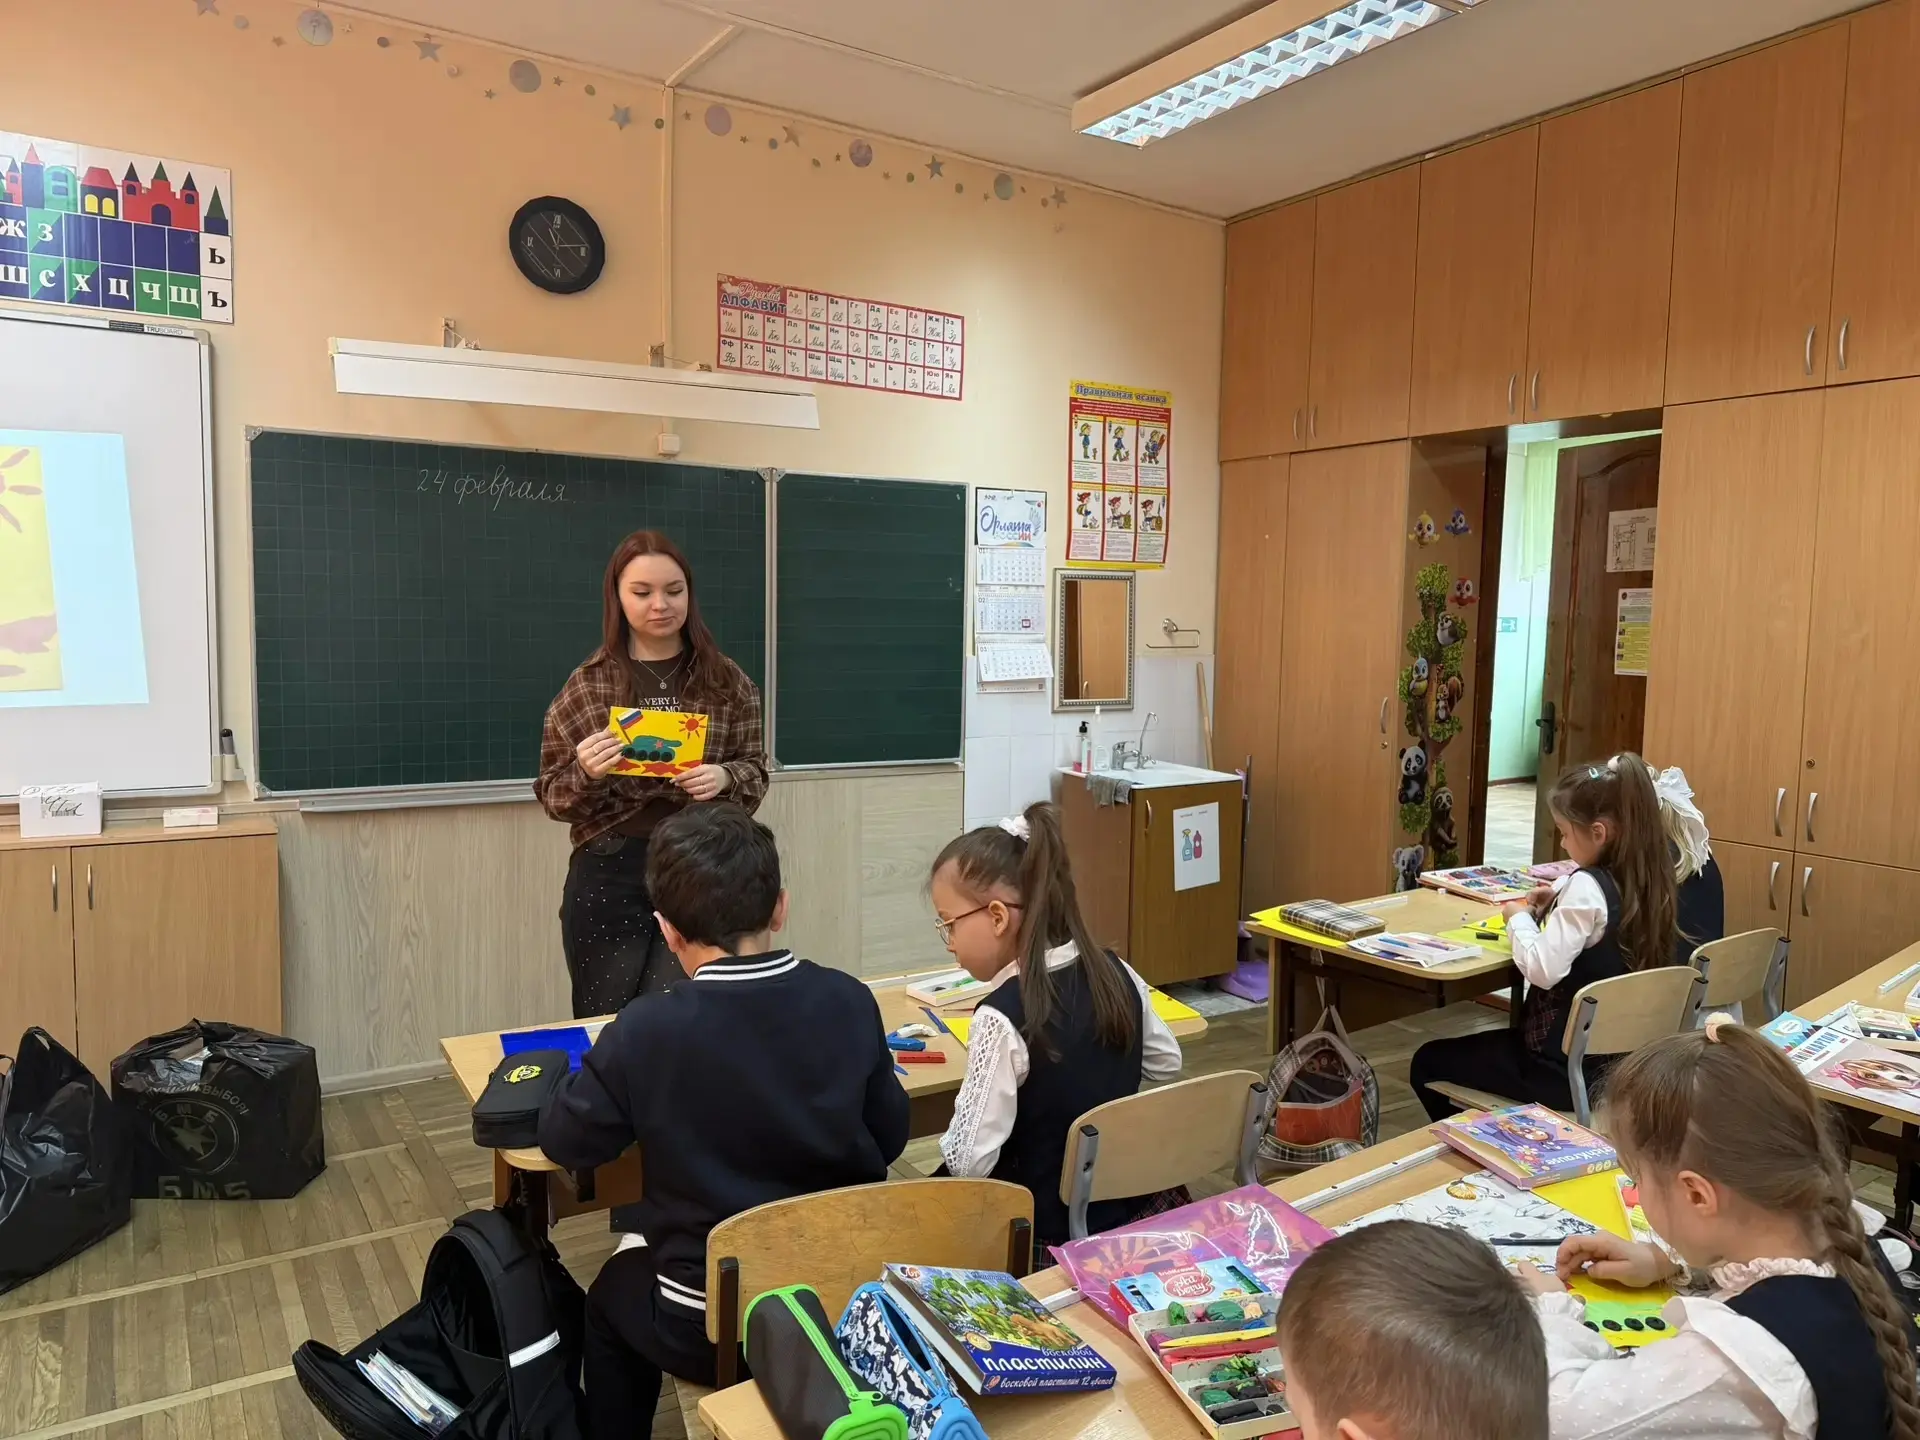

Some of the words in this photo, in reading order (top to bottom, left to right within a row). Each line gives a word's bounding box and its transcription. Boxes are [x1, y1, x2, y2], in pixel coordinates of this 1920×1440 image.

[721, 295, 787, 313] АЛФАВИТ
[767, 316, 776, 324] Кк
[1075, 383, 1133, 399] Правильная
[1136, 393, 1167, 404] осанка
[416, 469, 448, 494] 24
[980, 505, 1031, 536] Орлята
[1041, 1346, 1093, 1357] восковой
[982, 1357, 1107, 1371] пластилин
[1000, 1376, 1038, 1388] восковой
[1038, 1377, 1080, 1387] пластилин
[1081, 1376, 1091, 1386] 12
